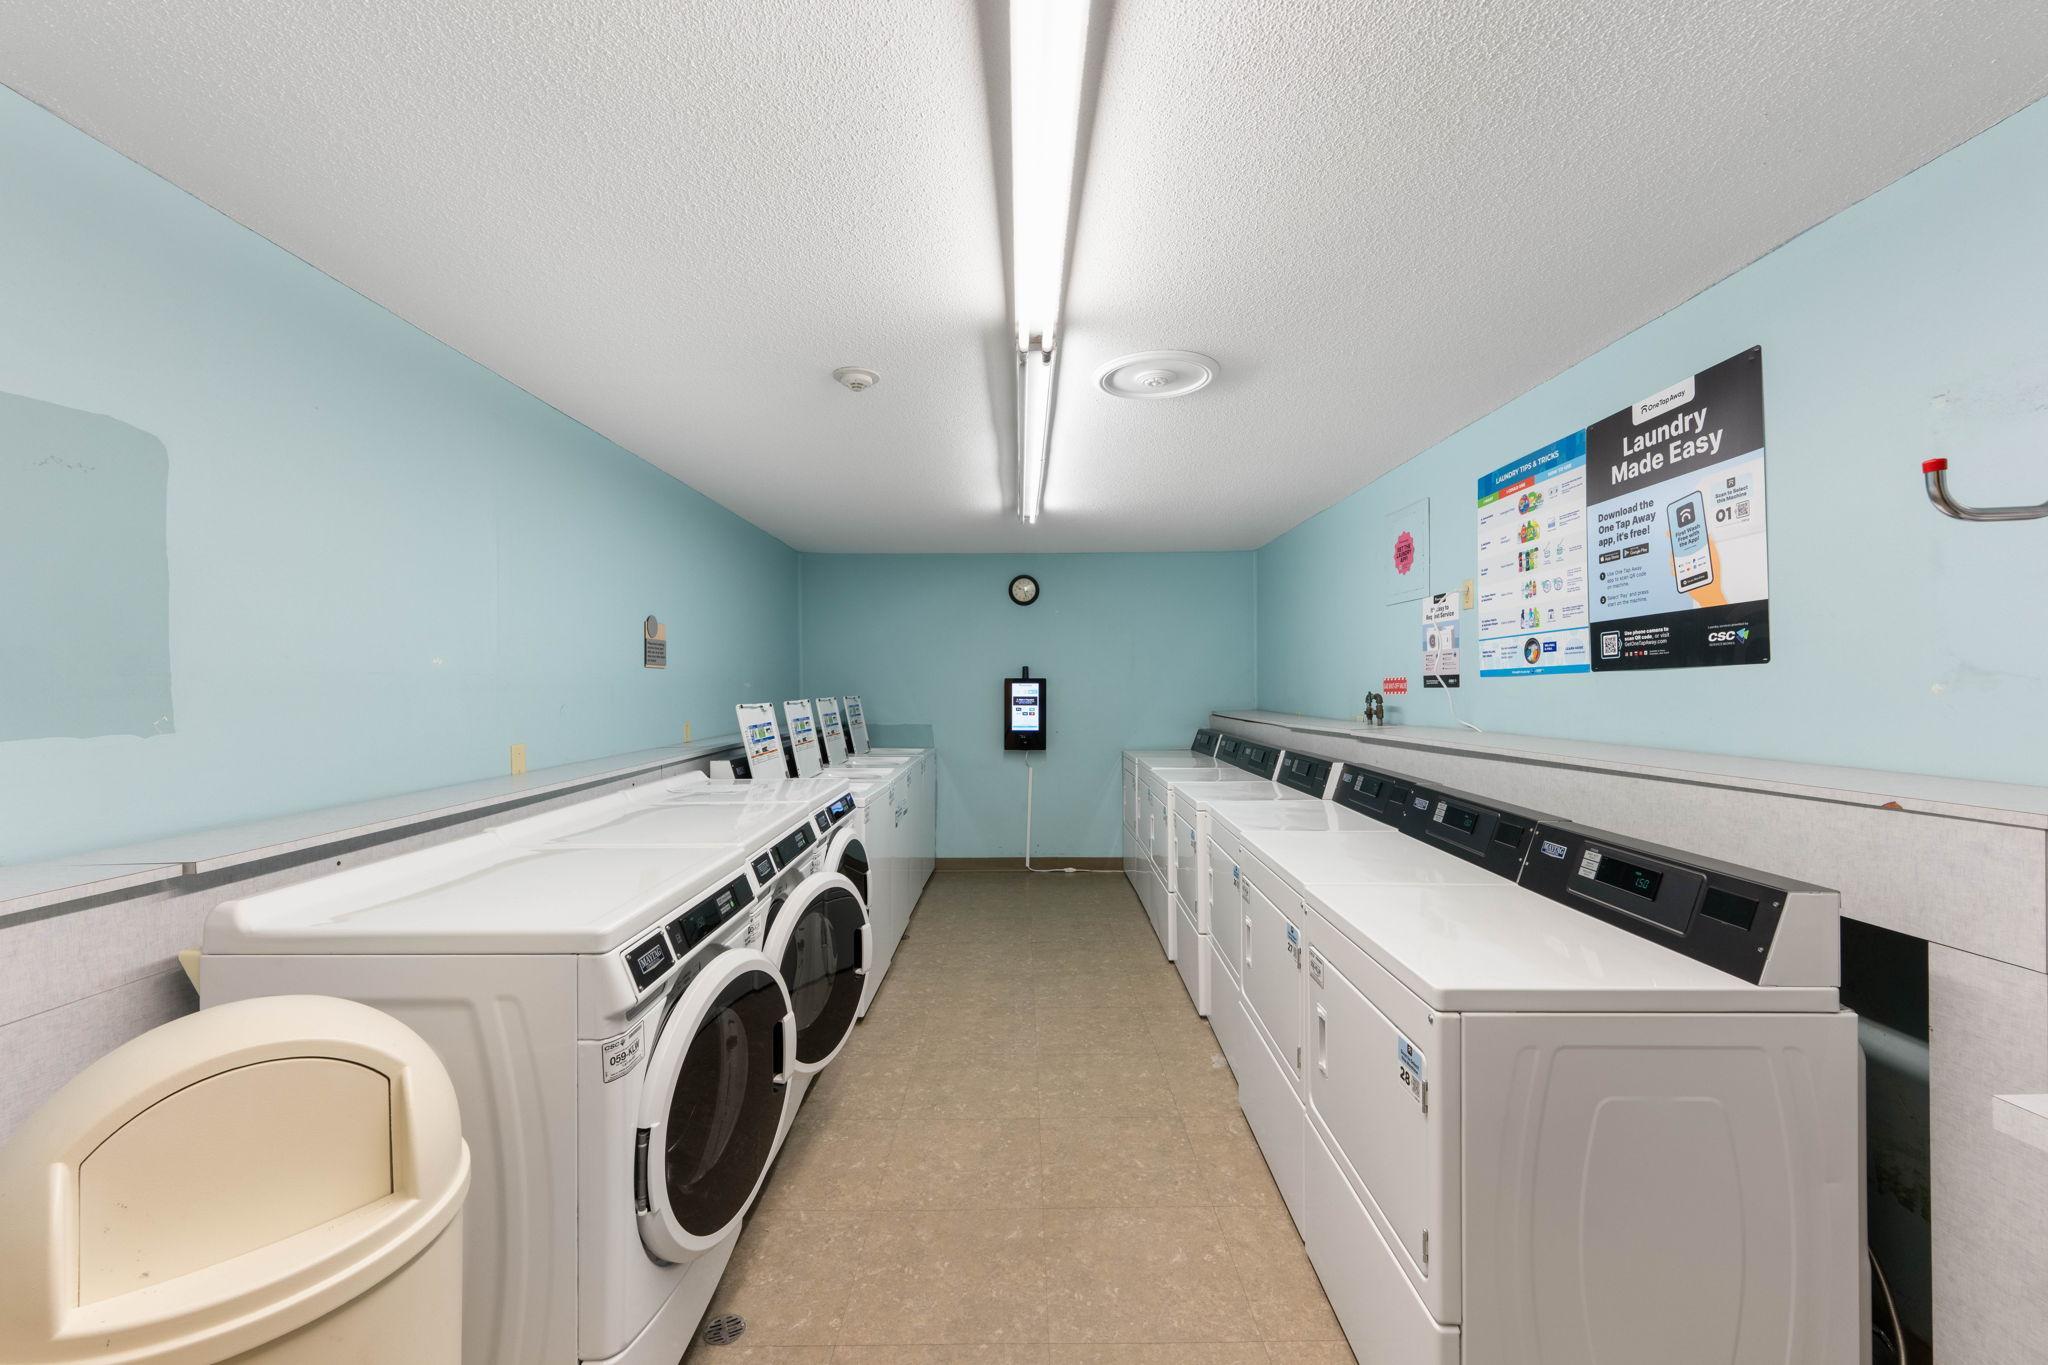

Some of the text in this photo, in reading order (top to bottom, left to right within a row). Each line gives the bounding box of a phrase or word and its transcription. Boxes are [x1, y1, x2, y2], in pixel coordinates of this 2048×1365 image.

[1648, 390, 1685, 411] One Tap Away
[1622, 407, 1708, 457] Laundry
[1496, 468, 1519, 484] LAUNDRY
[1520, 462, 1532, 472] TIPS
[1538, 450, 1559, 465] TRICKS
[1611, 429, 1724, 485] Made Easy
[1726, 492, 1747, 500] Machine
[1733, 485, 1748, 493] Select
[1598, 503, 1638, 522] Download
[1639, 500, 1654, 510] the
[1716, 506, 1731, 522] 01
[1599, 512, 1656, 534] One Tap Away
[1676, 524, 1700, 538] First Wash
[1599, 525, 1650, 547] app, it's free!
[1708, 631, 1735, 642] CSC
[1542, 842, 1565, 855] MAYTAG
[640, 947, 662, 968] MAYTAG
[1400, 1066, 1410, 1086] 28
